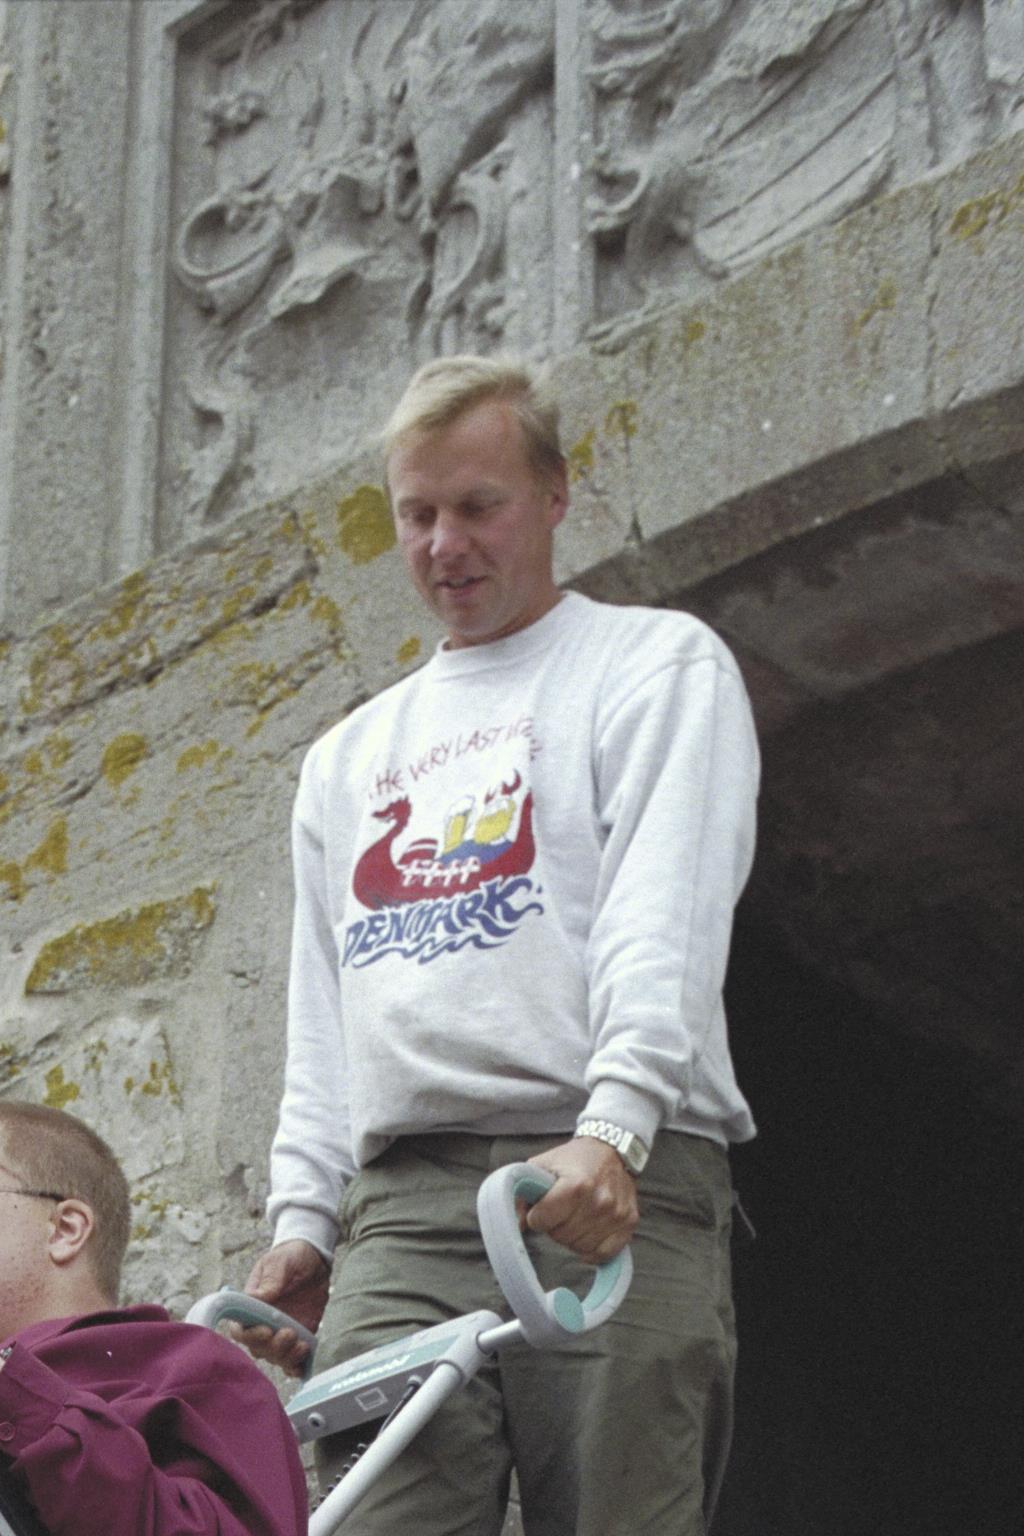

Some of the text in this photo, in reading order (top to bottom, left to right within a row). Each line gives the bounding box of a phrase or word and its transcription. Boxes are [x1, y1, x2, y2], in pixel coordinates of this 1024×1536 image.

[369, 768, 405, 800] HE
[409, 740, 452, 782] VERY
[341, 877, 544, 968] DENMARK
